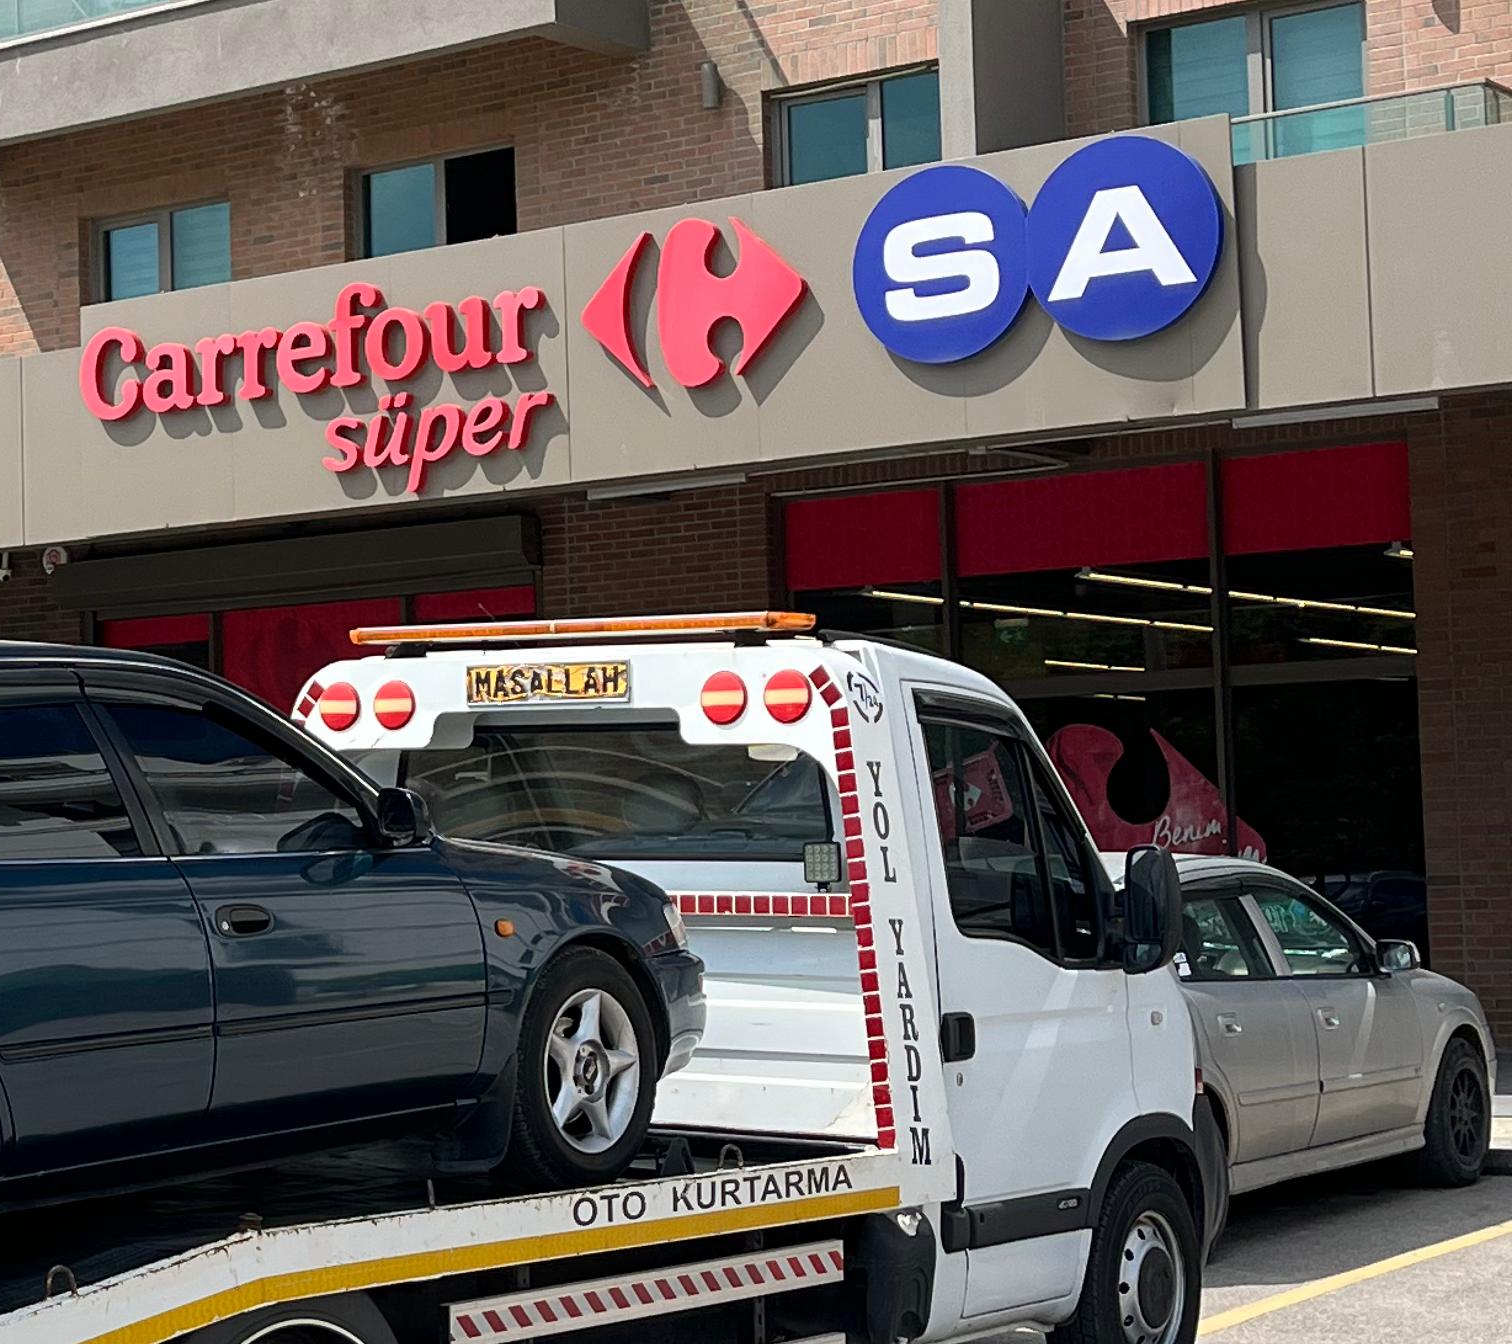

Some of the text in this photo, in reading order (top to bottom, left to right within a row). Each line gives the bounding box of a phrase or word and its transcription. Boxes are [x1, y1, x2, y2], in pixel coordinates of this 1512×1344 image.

[79, 282, 547, 422] Carrefour
[322, 391, 556, 493] süper
[866, 760, 898, 883] YOL
[888, 918, 933, 1166] YARDIM
[573, 1163, 854, 1227] OTO KURTARMA
